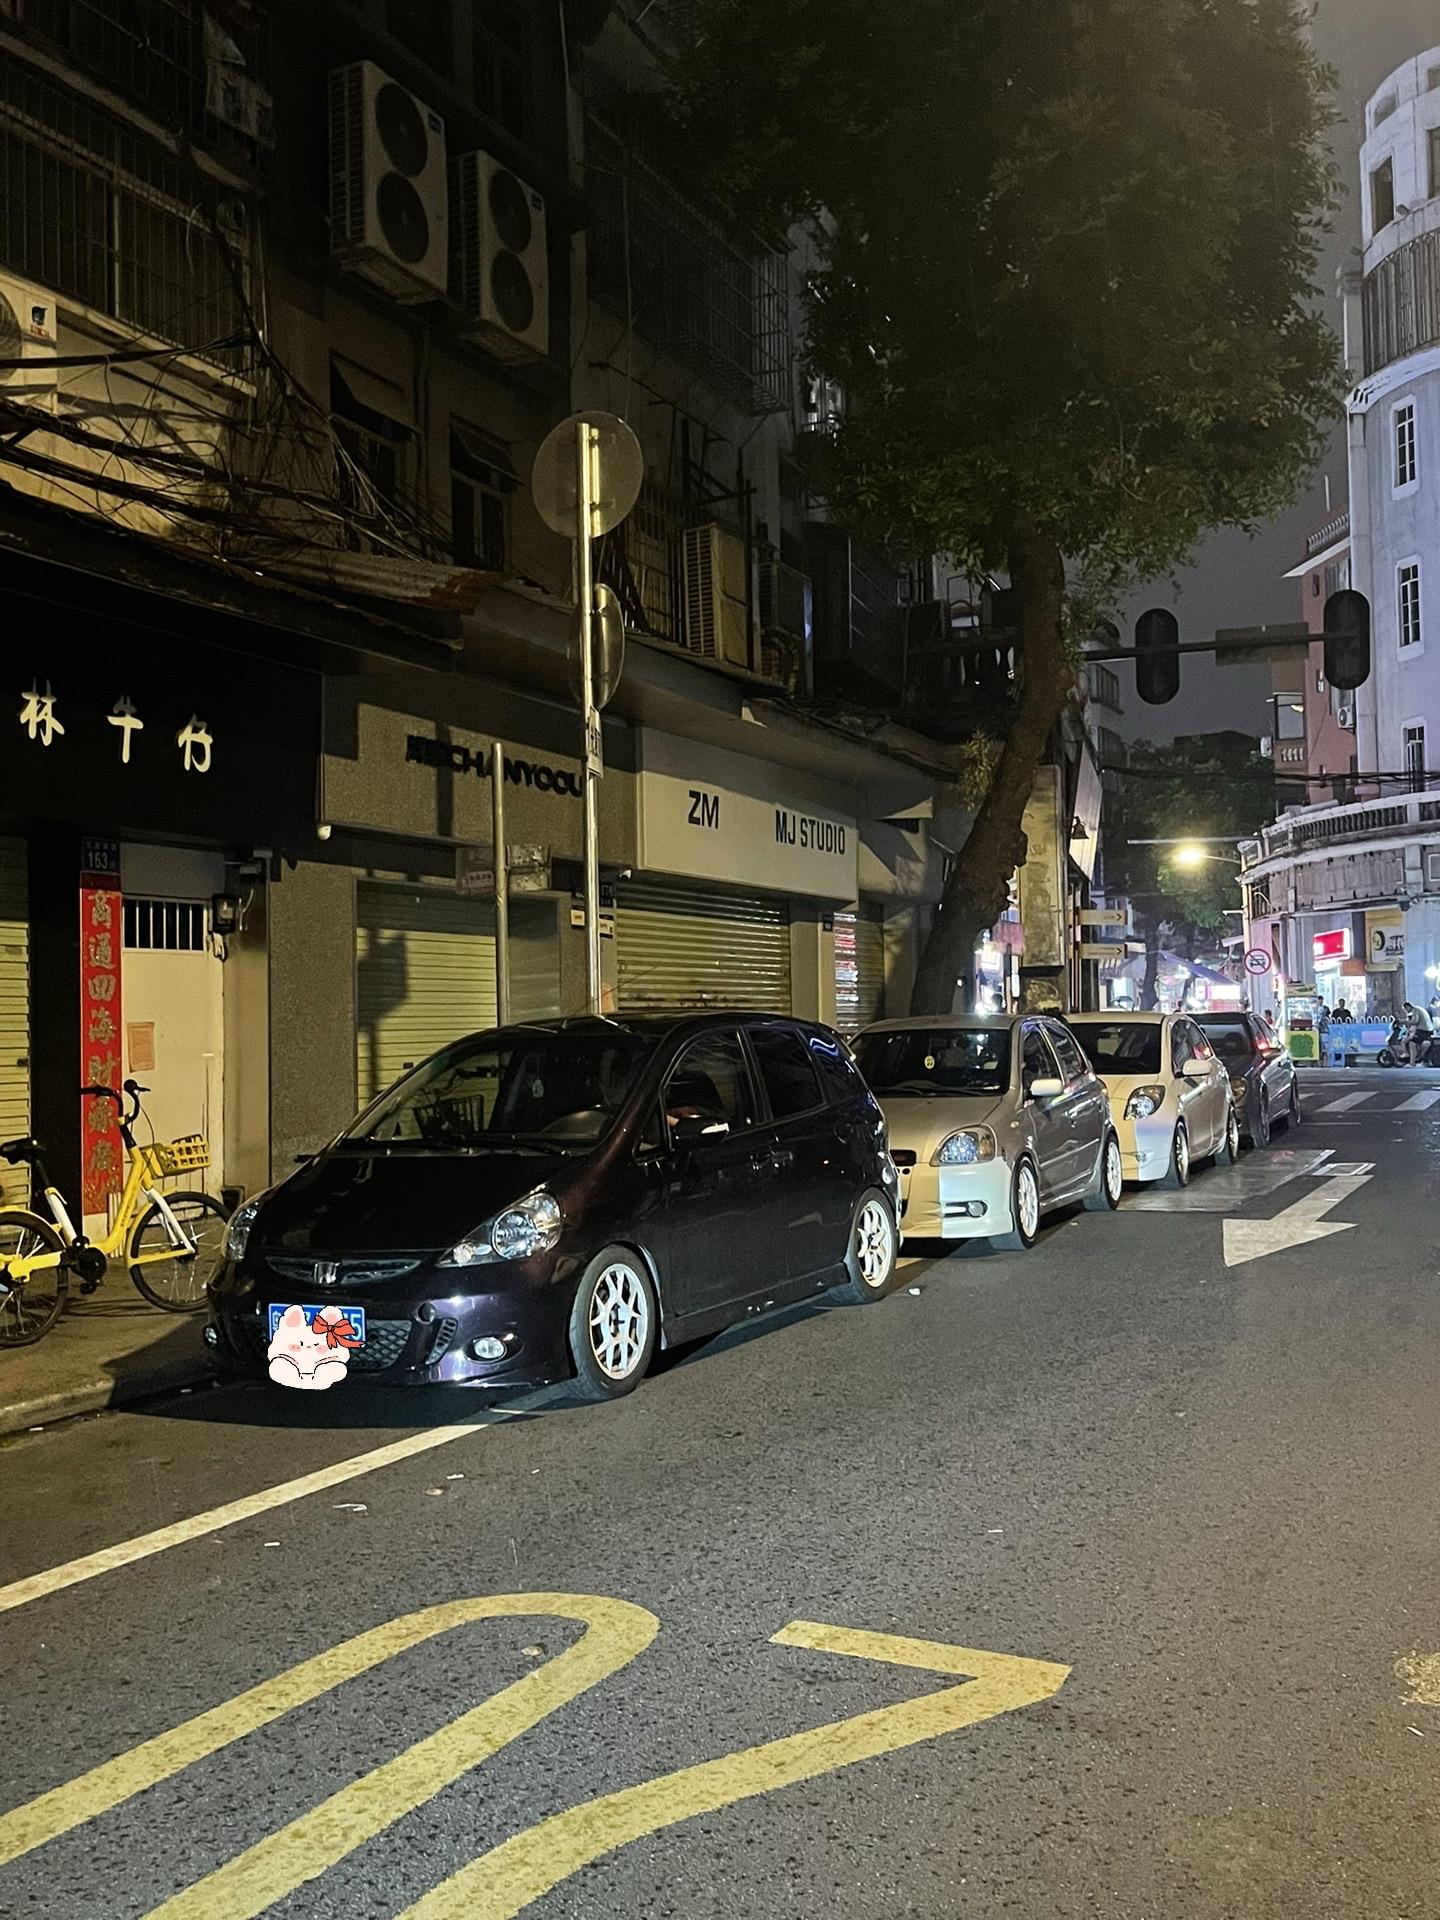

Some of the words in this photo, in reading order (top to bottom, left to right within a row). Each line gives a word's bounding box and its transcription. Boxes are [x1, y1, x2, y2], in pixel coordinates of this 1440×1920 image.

[688, 790, 719, 829] ZM
[776, 810, 796, 845] MJ
[801, 818, 846, 855] STUDIO
